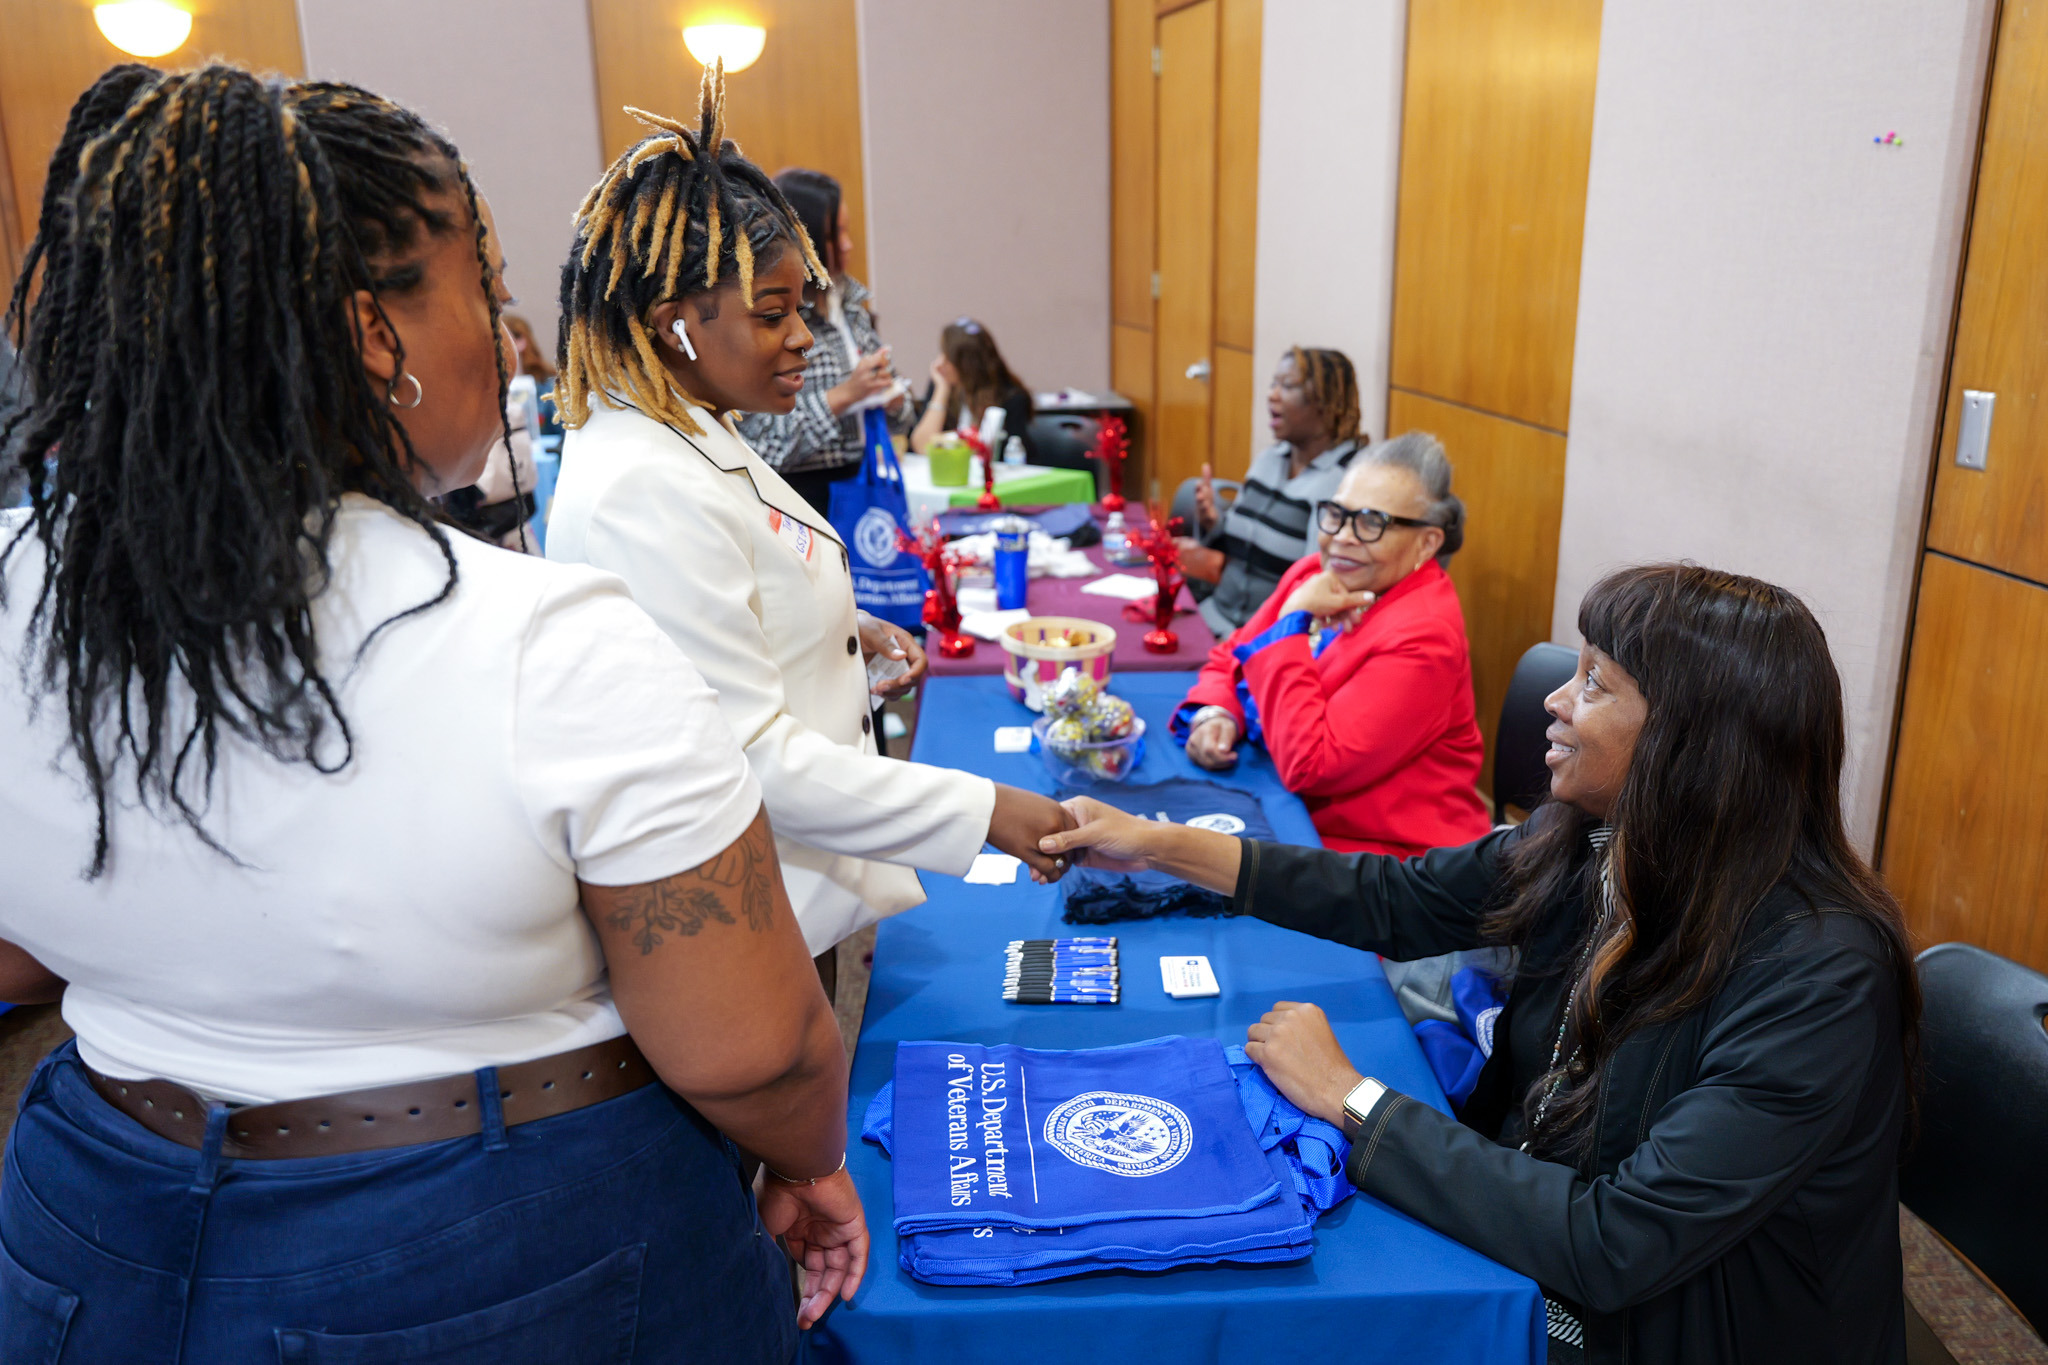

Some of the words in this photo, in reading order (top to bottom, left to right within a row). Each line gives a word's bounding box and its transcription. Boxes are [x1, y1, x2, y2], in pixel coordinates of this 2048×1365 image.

[948, 1054, 974, 1073] of
[981, 1062, 1006, 1096] U.S.
[948, 1073, 973, 1151] Veterans
[1064, 1100, 1096, 1117] UNITED
[1104, 1098, 1168, 1118] DEPARTMENT
[976, 1097, 1013, 1199] Department
[1117, 1158, 1159, 1169] AFFAIRS
[950, 1154, 979, 1207] Affairs
